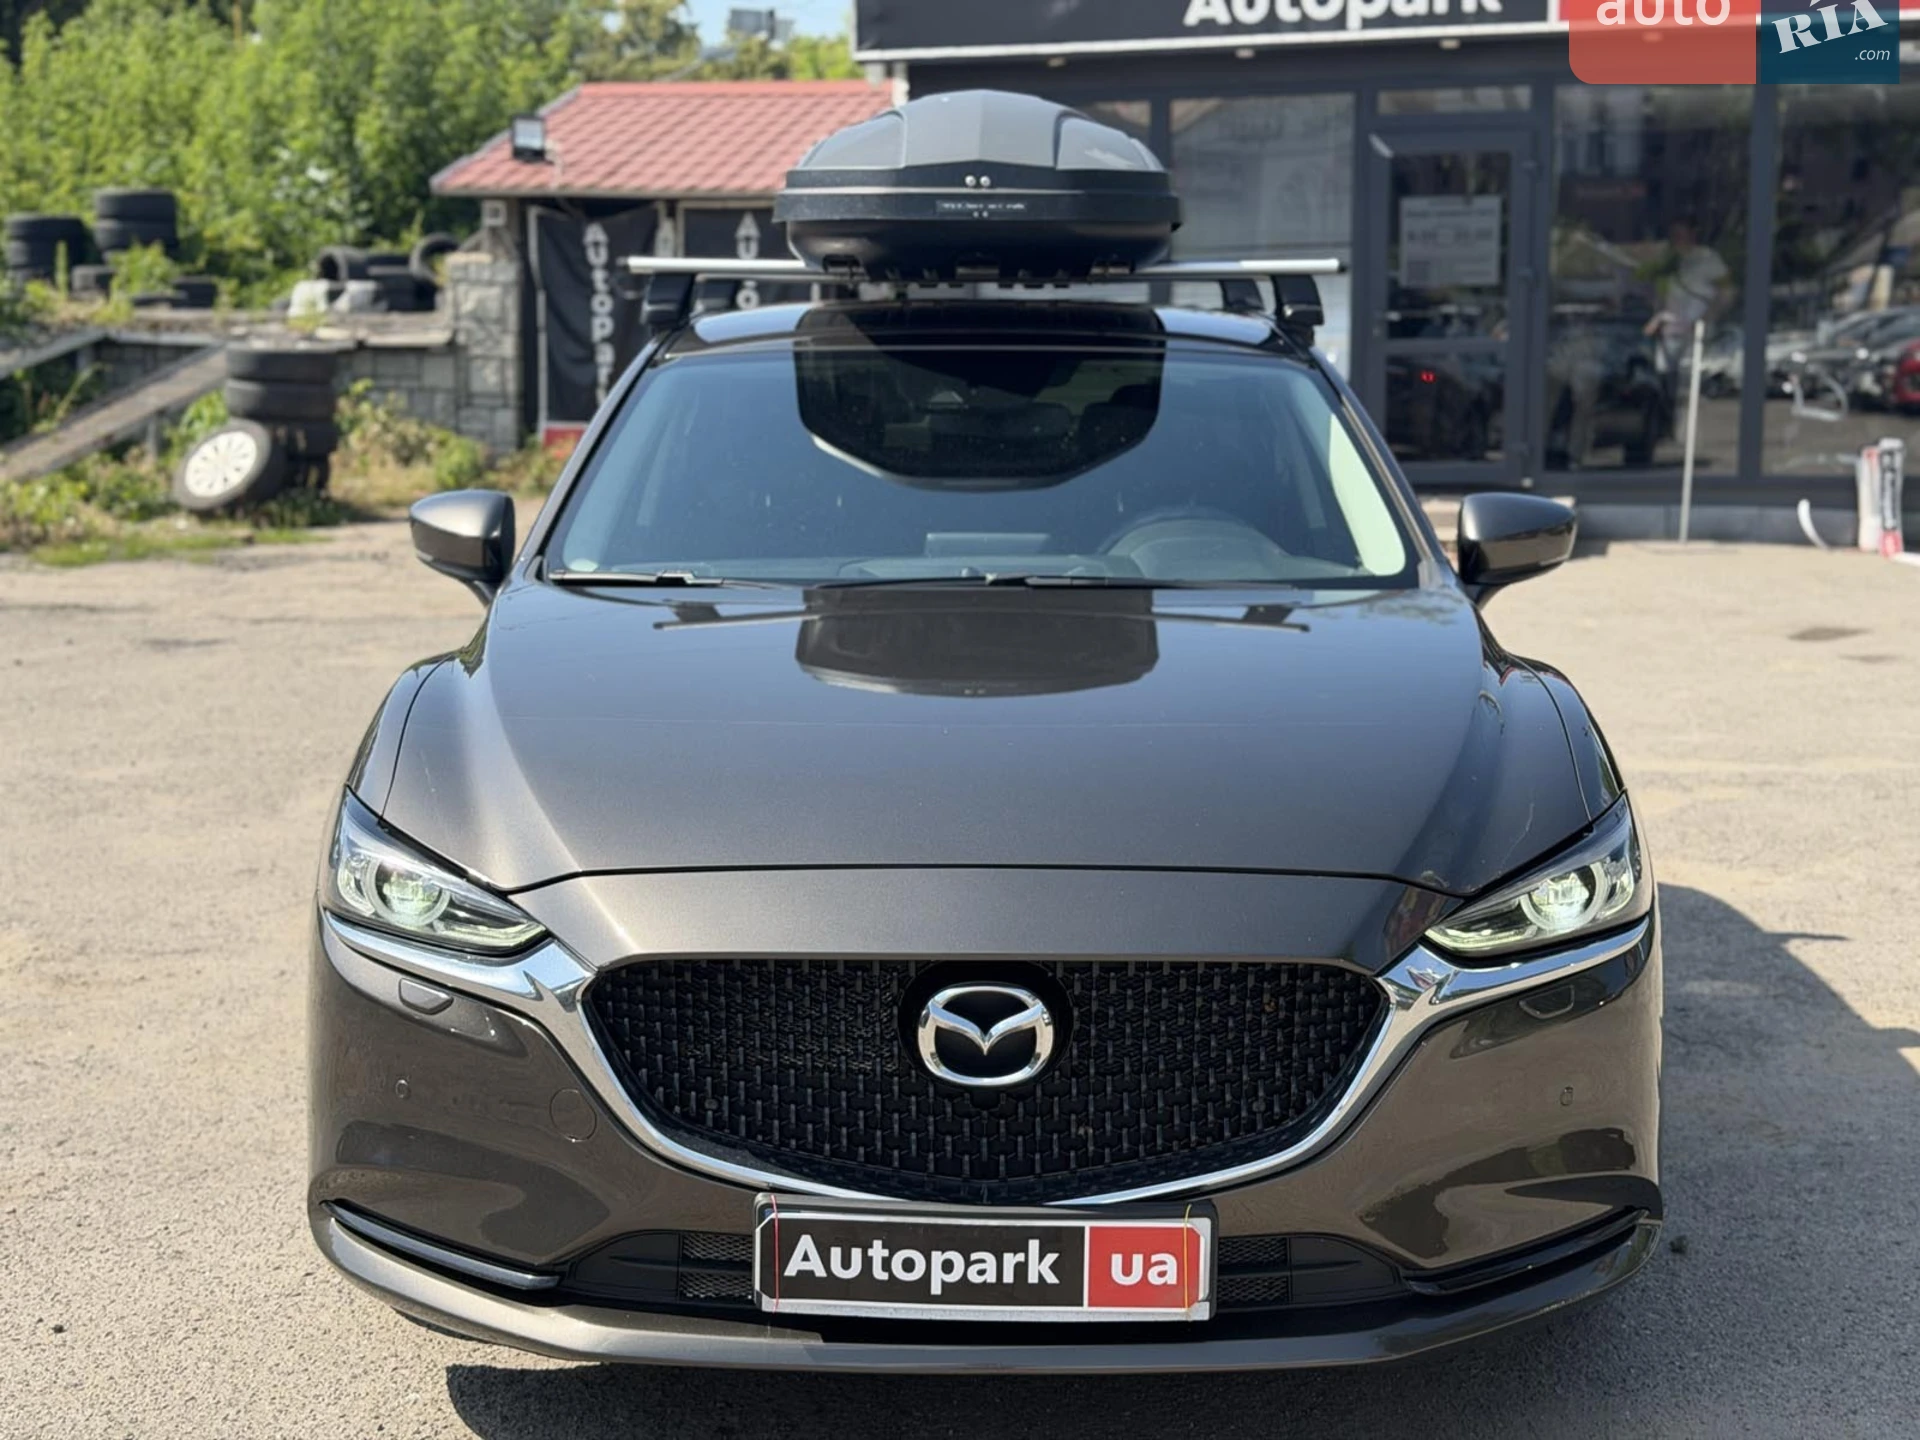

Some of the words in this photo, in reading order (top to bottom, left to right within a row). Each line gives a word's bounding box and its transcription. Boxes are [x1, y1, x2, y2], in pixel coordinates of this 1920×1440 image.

[1182, 0, 1503, 30] Autop
[783, 1234, 1060, 1295] Autopark
[1110, 1252, 1178, 1286] ua
